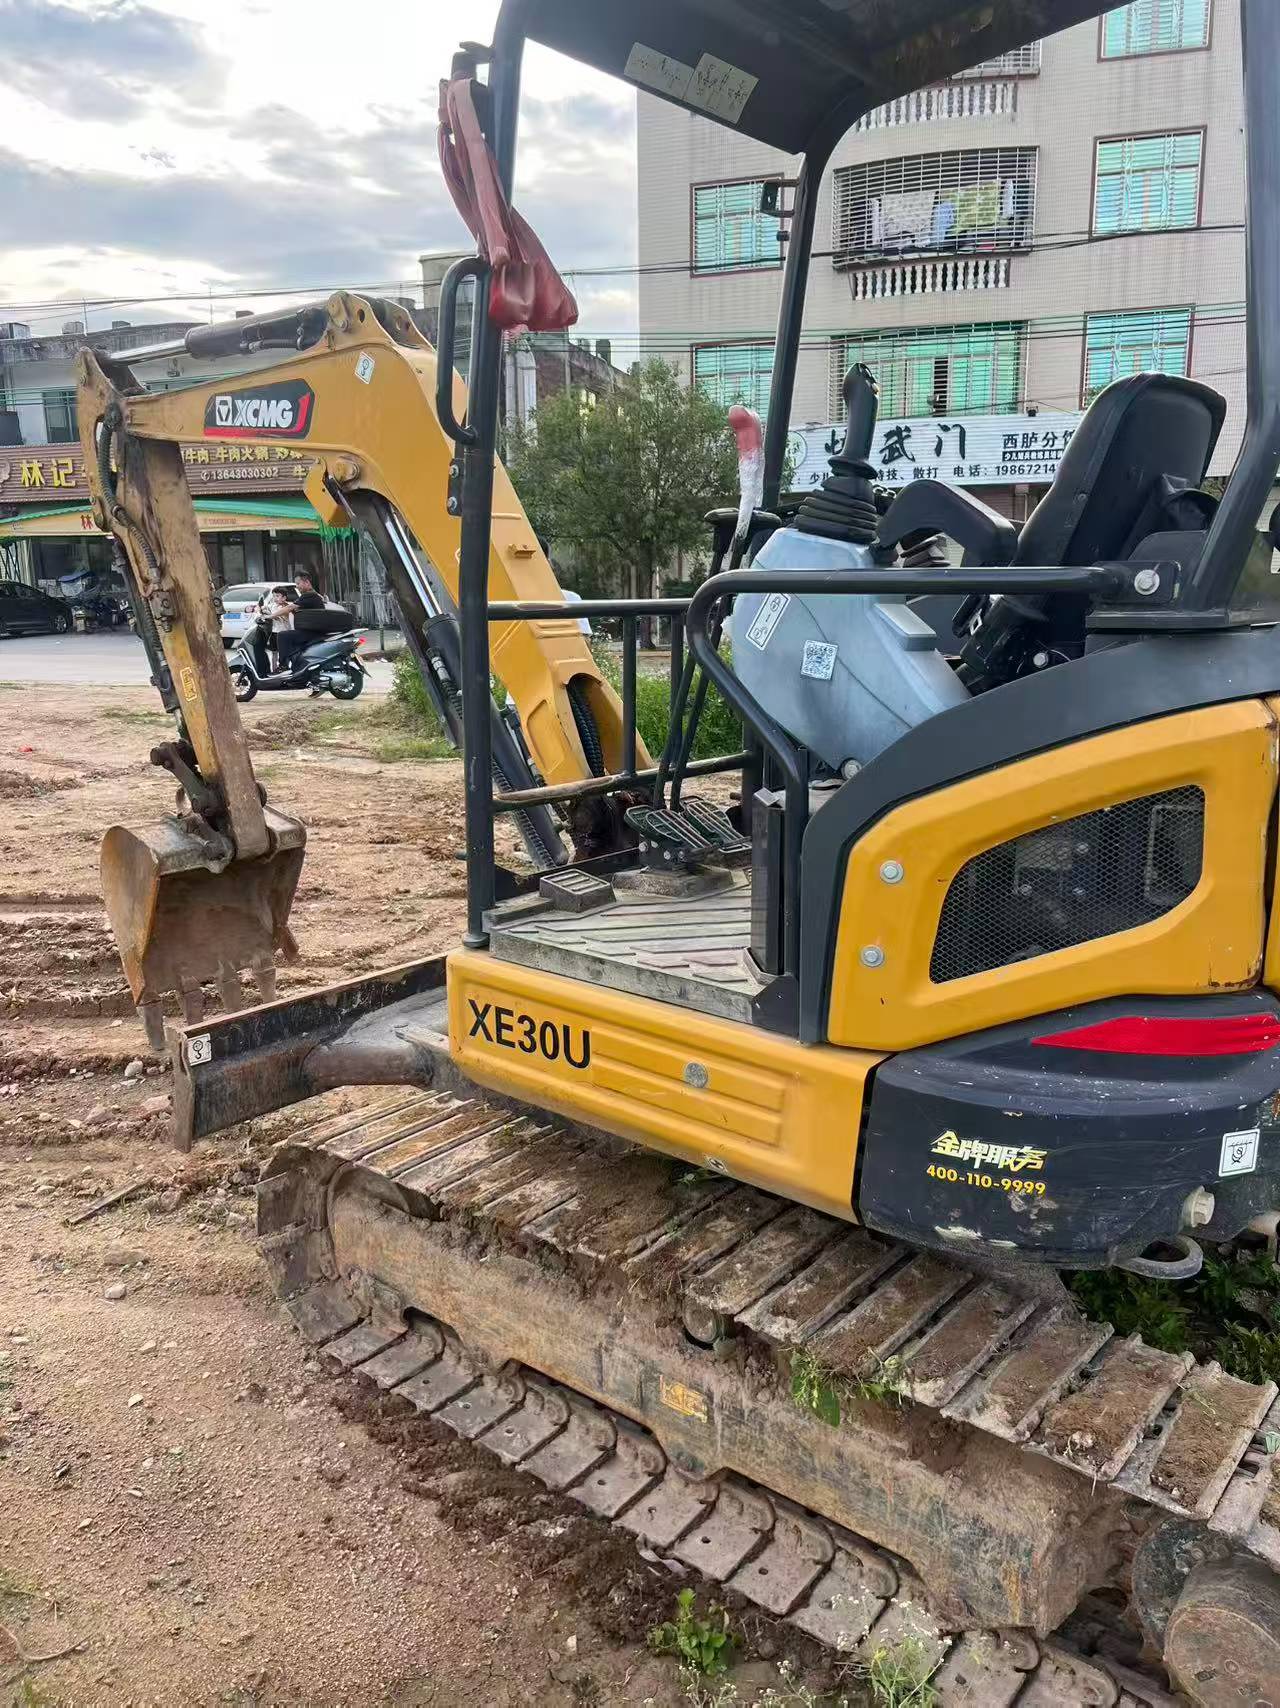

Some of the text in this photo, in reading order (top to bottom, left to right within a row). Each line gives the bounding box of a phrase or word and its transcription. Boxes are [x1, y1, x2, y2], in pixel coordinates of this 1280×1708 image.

[234, 399, 293, 428] XCMG
[181, 448, 210, 465] 牛肉
[995, 463, 1058, 477] 19867214
[20, 458, 85, 488] 林记
[468, 999, 591, 1070] XE30U
[930, 1130, 1048, 1172] 金牌服务
[926, 1164, 1046, 1196] 400-110-9999
